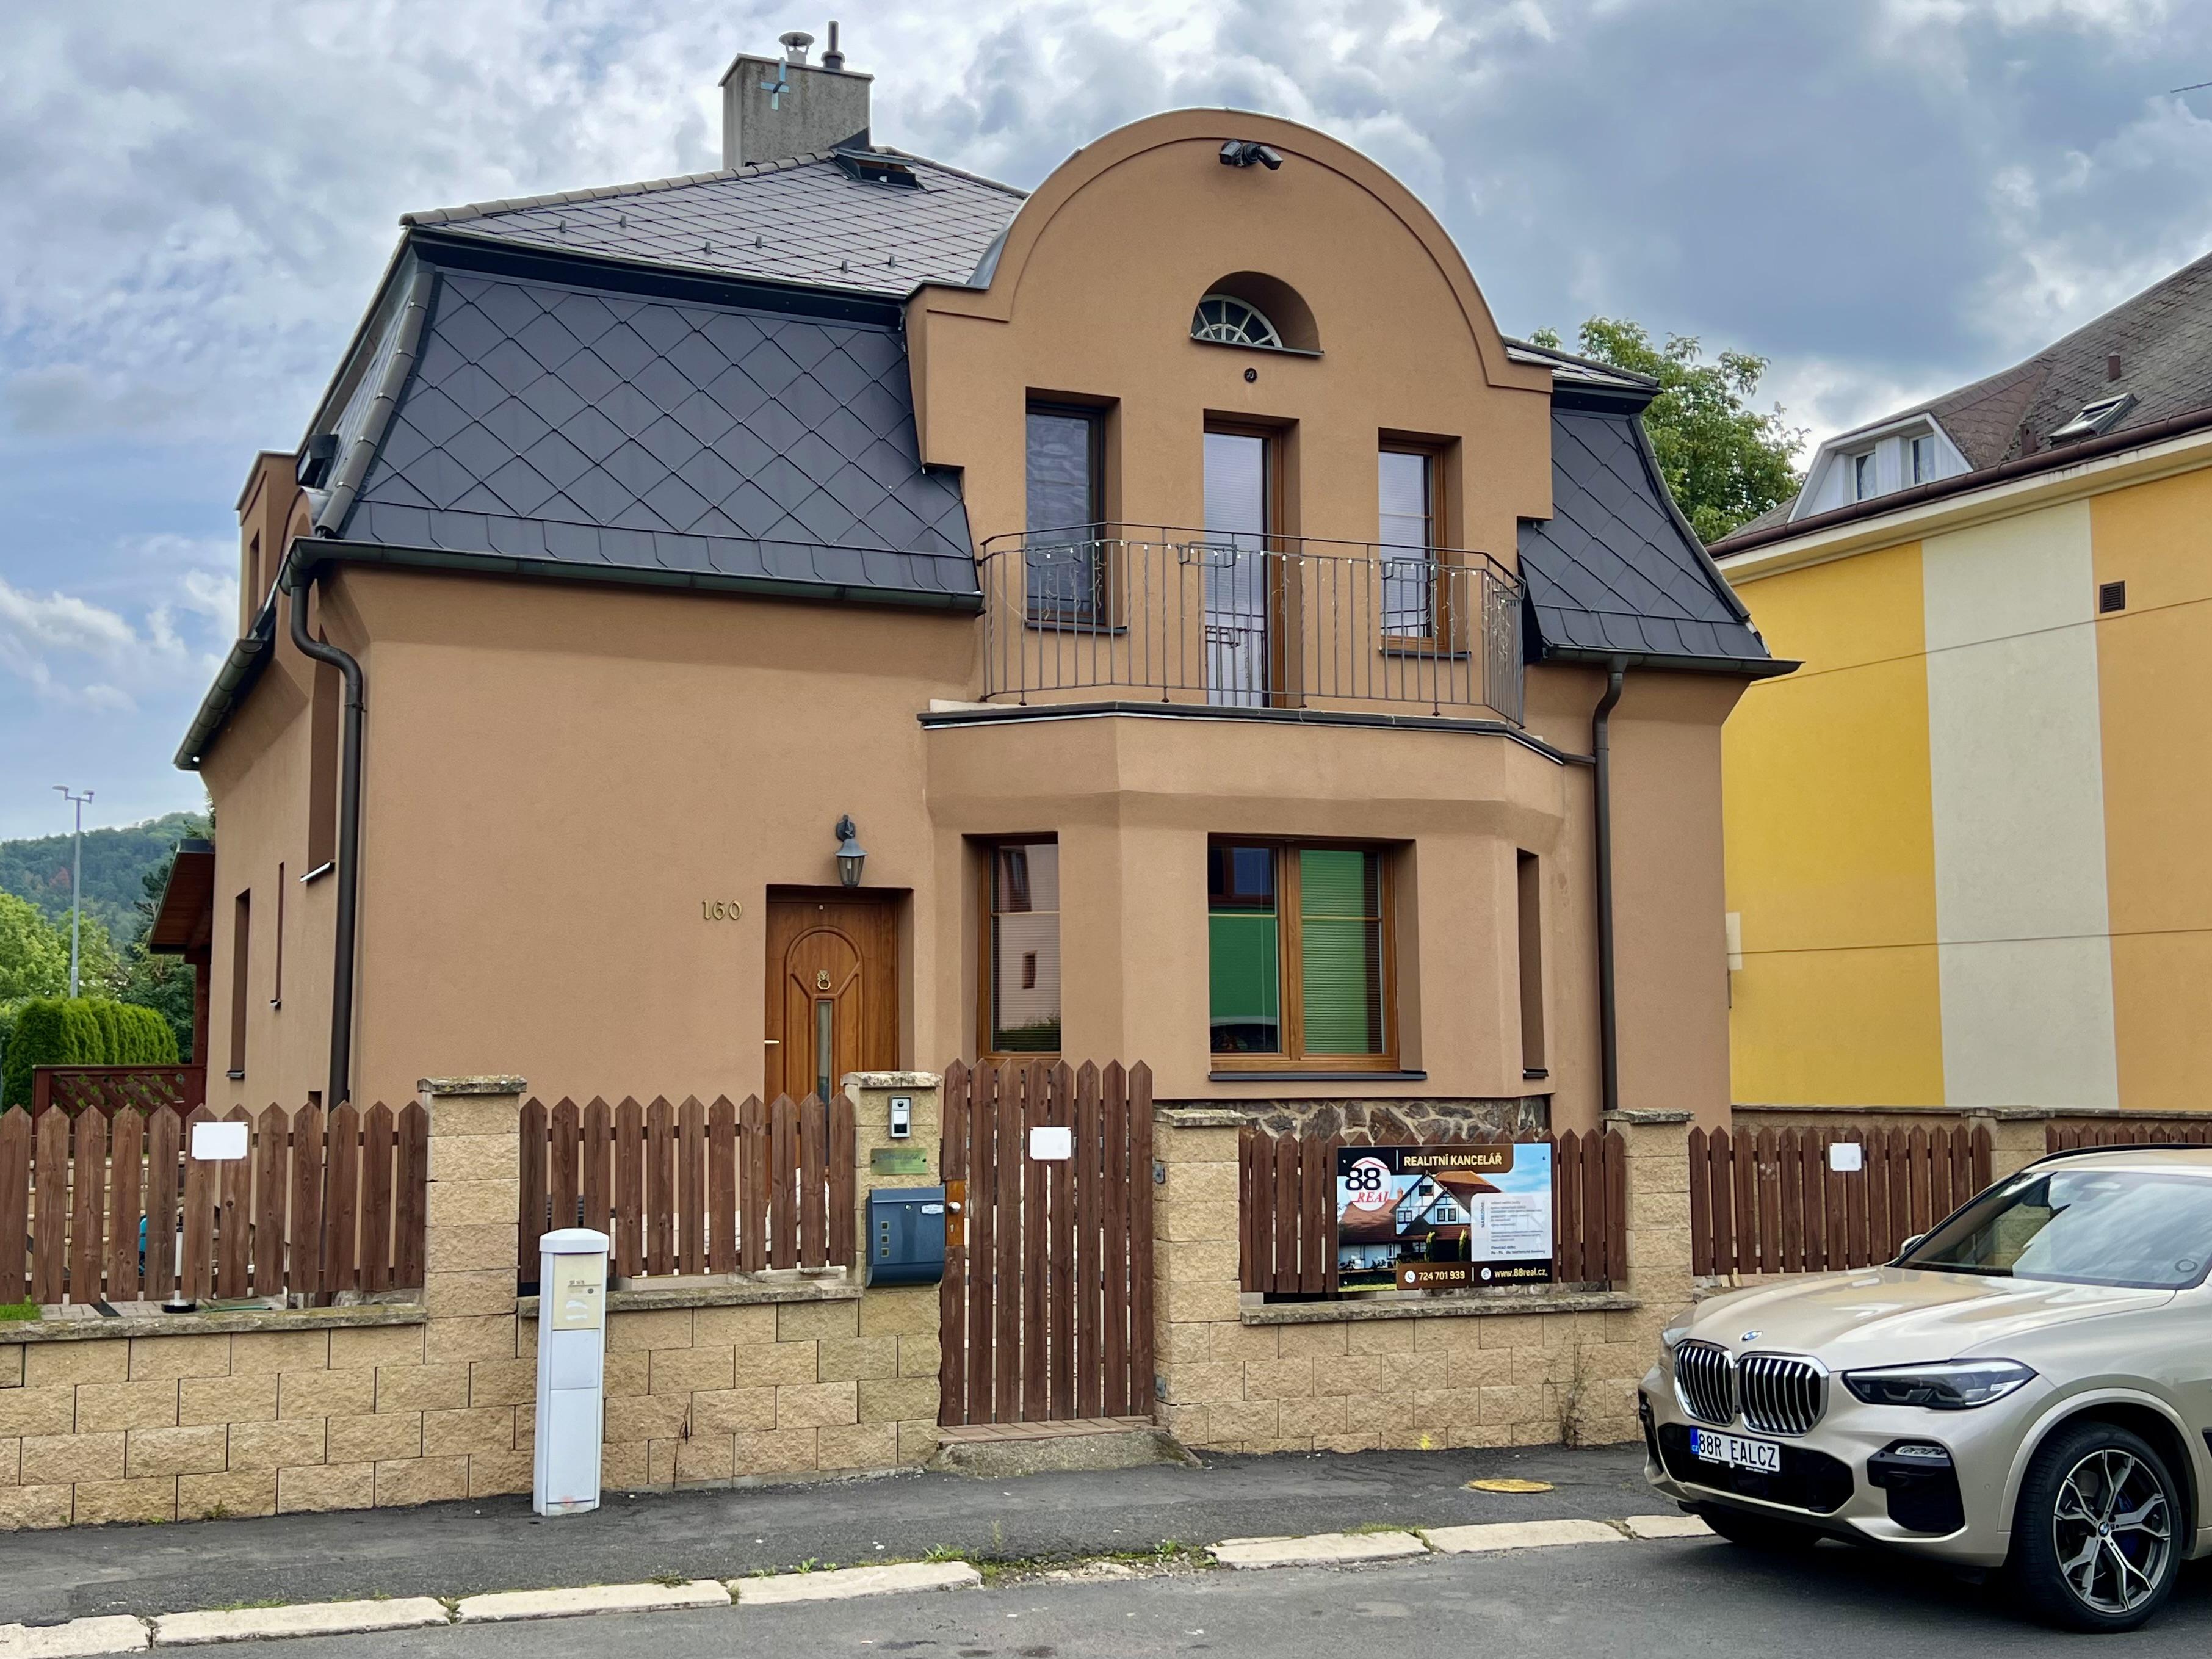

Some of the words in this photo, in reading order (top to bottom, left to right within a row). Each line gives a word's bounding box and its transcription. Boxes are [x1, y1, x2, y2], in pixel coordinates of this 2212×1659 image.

[702, 899, 743, 920] 160
[1403, 1154, 1449, 1166] REALITNÍ
[1450, 1152, 1502, 1166] KANCELÁŘ
[1345, 1167, 1381, 1191] 88
[1419, 1272, 1433, 1281] 724
[1434, 1271, 1448, 1281] 701
[1449, 1270, 1465, 1280] 939
[1494, 1267, 1546, 1278] www.88real.cz
[1699, 1433, 1721, 1456] 88R
[1730, 1440, 1776, 1468] EALCZ
